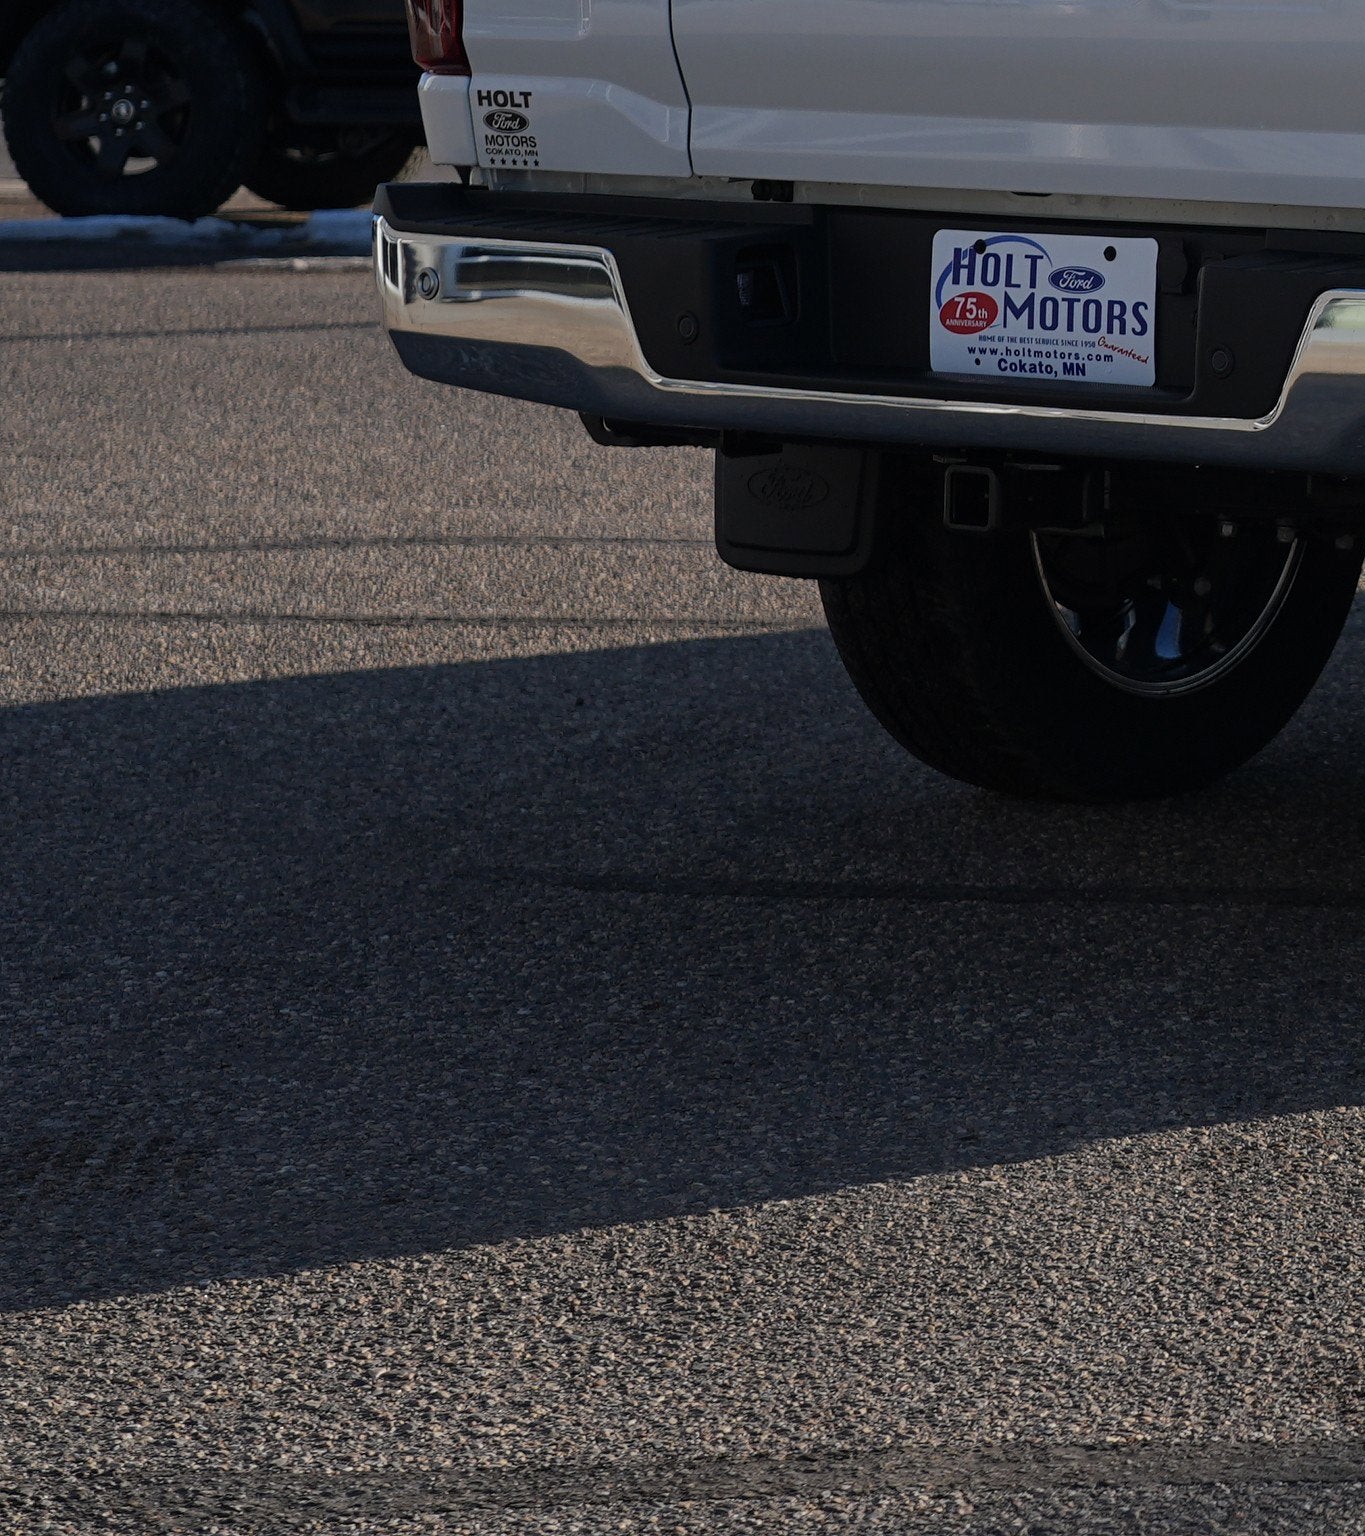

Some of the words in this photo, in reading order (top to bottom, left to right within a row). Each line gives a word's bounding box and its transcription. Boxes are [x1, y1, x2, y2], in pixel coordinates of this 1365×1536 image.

[477, 90, 532, 108] HOLT
[492, 112, 520, 130] Ford
[485, 134, 536, 148] MOTORS
[952, 247, 1043, 289] HOLT
[1059, 269, 1093, 290] Ford
[954, 297, 987, 319] 75th
[1003, 289, 1148, 336] MOTORS
[945, 319, 986, 327] ANNIVERSARY
[1061, 339, 1078, 347] SINCE
[1081, 340, 1096, 348] 1950
[967, 346, 1113, 362] www.holtmotors.com
[998, 358, 1058, 378] Cokato,
[1062, 362, 1086, 376] MN
